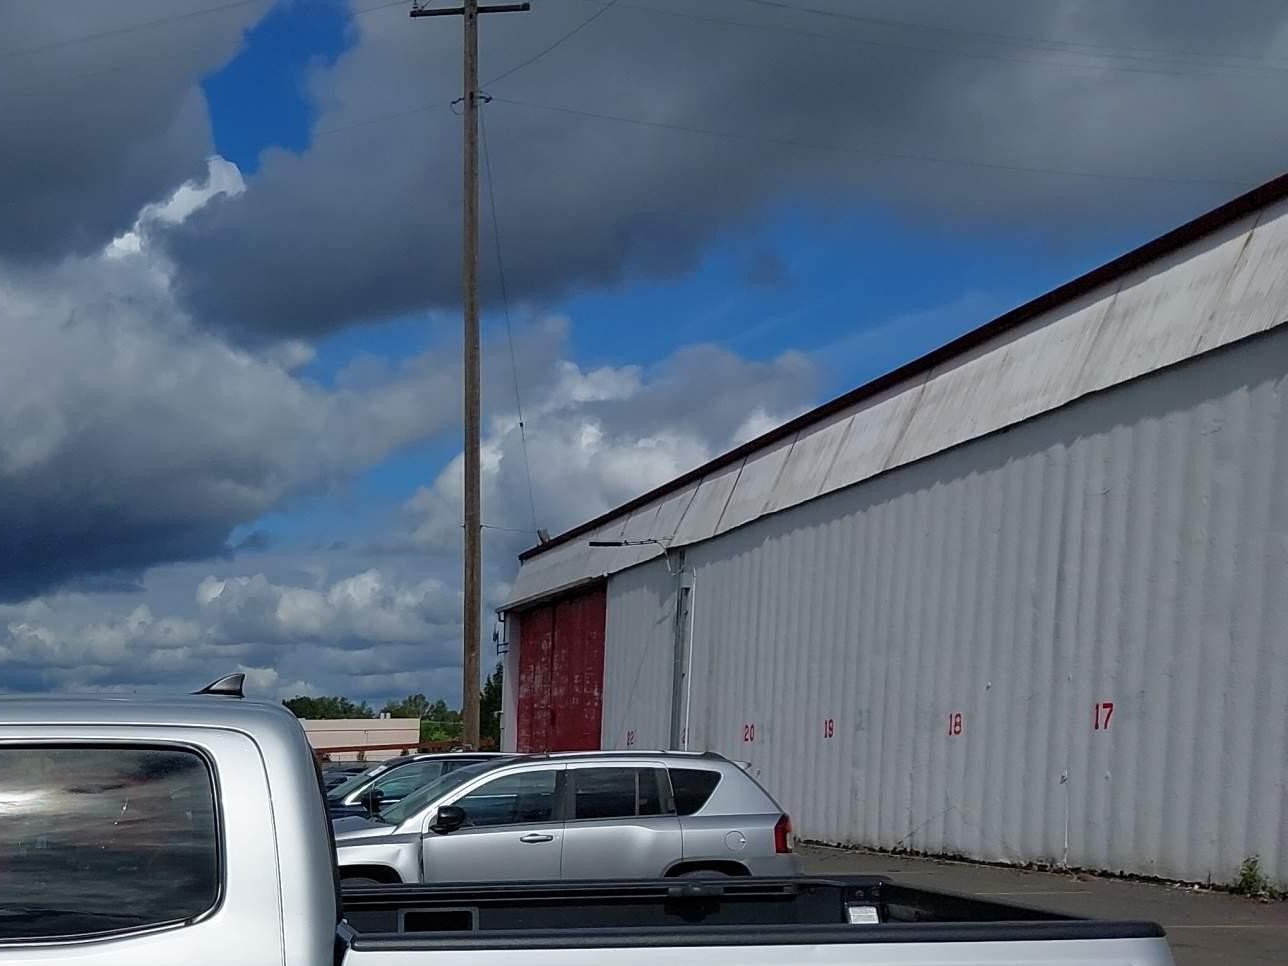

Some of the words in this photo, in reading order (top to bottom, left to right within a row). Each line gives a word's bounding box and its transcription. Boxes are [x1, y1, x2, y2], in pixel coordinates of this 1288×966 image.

[948, 713, 962, 736] 18
[1094, 703, 1113, 730] 17
[744, 724, 755, 742] 20
[824, 719, 834, 738] 19
